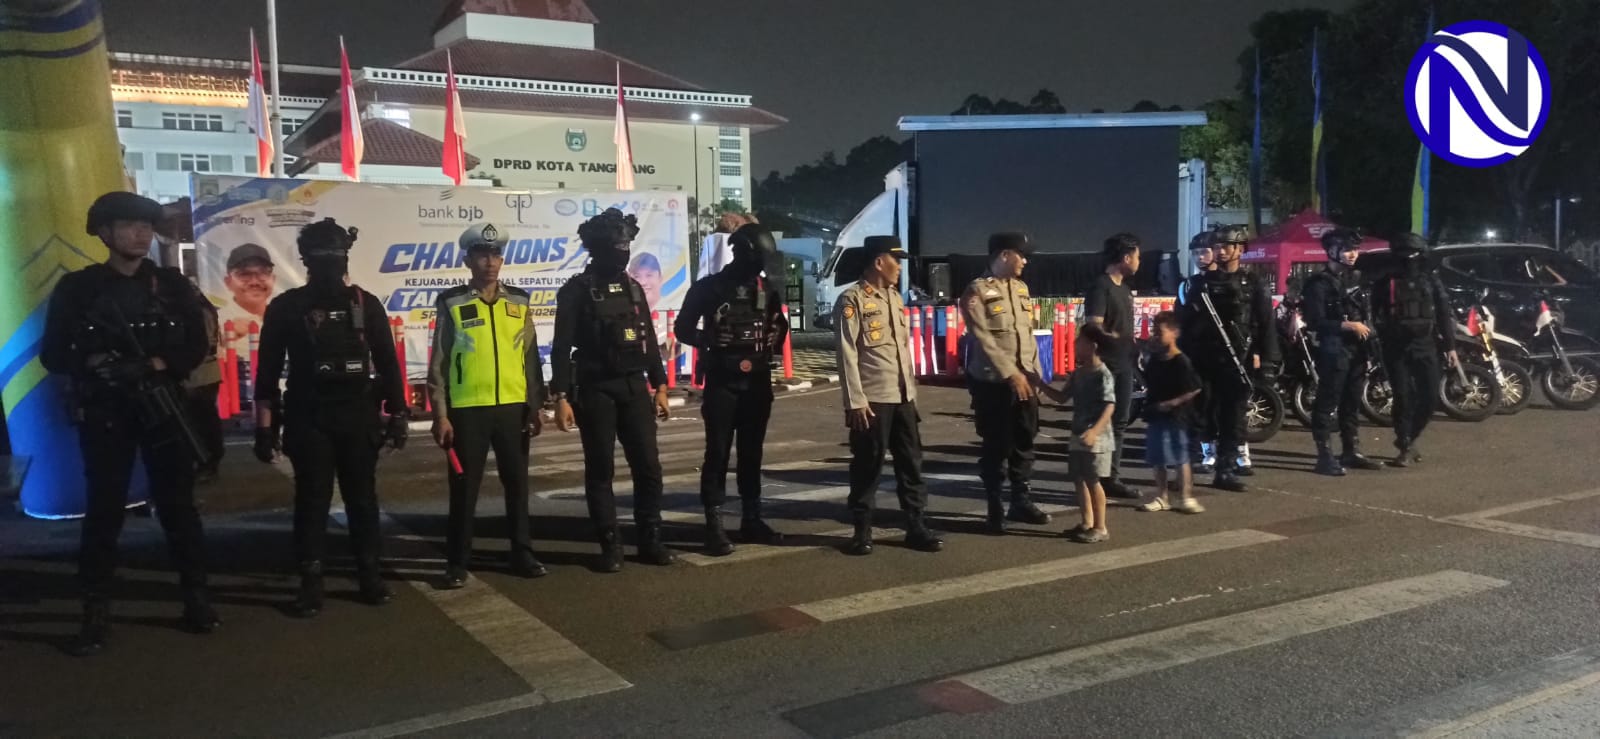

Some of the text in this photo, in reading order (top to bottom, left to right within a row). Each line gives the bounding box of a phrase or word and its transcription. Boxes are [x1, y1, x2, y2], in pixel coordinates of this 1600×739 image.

[493, 158, 532, 170] DPRD
[536, 160, 574, 172] KOTA
[418, 204, 484, 222] bank bjb
[379, 236, 569, 275] CHAIONS
[404, 277, 466, 287] KEJUARAAN
[518, 277, 553, 286] SEPATU
